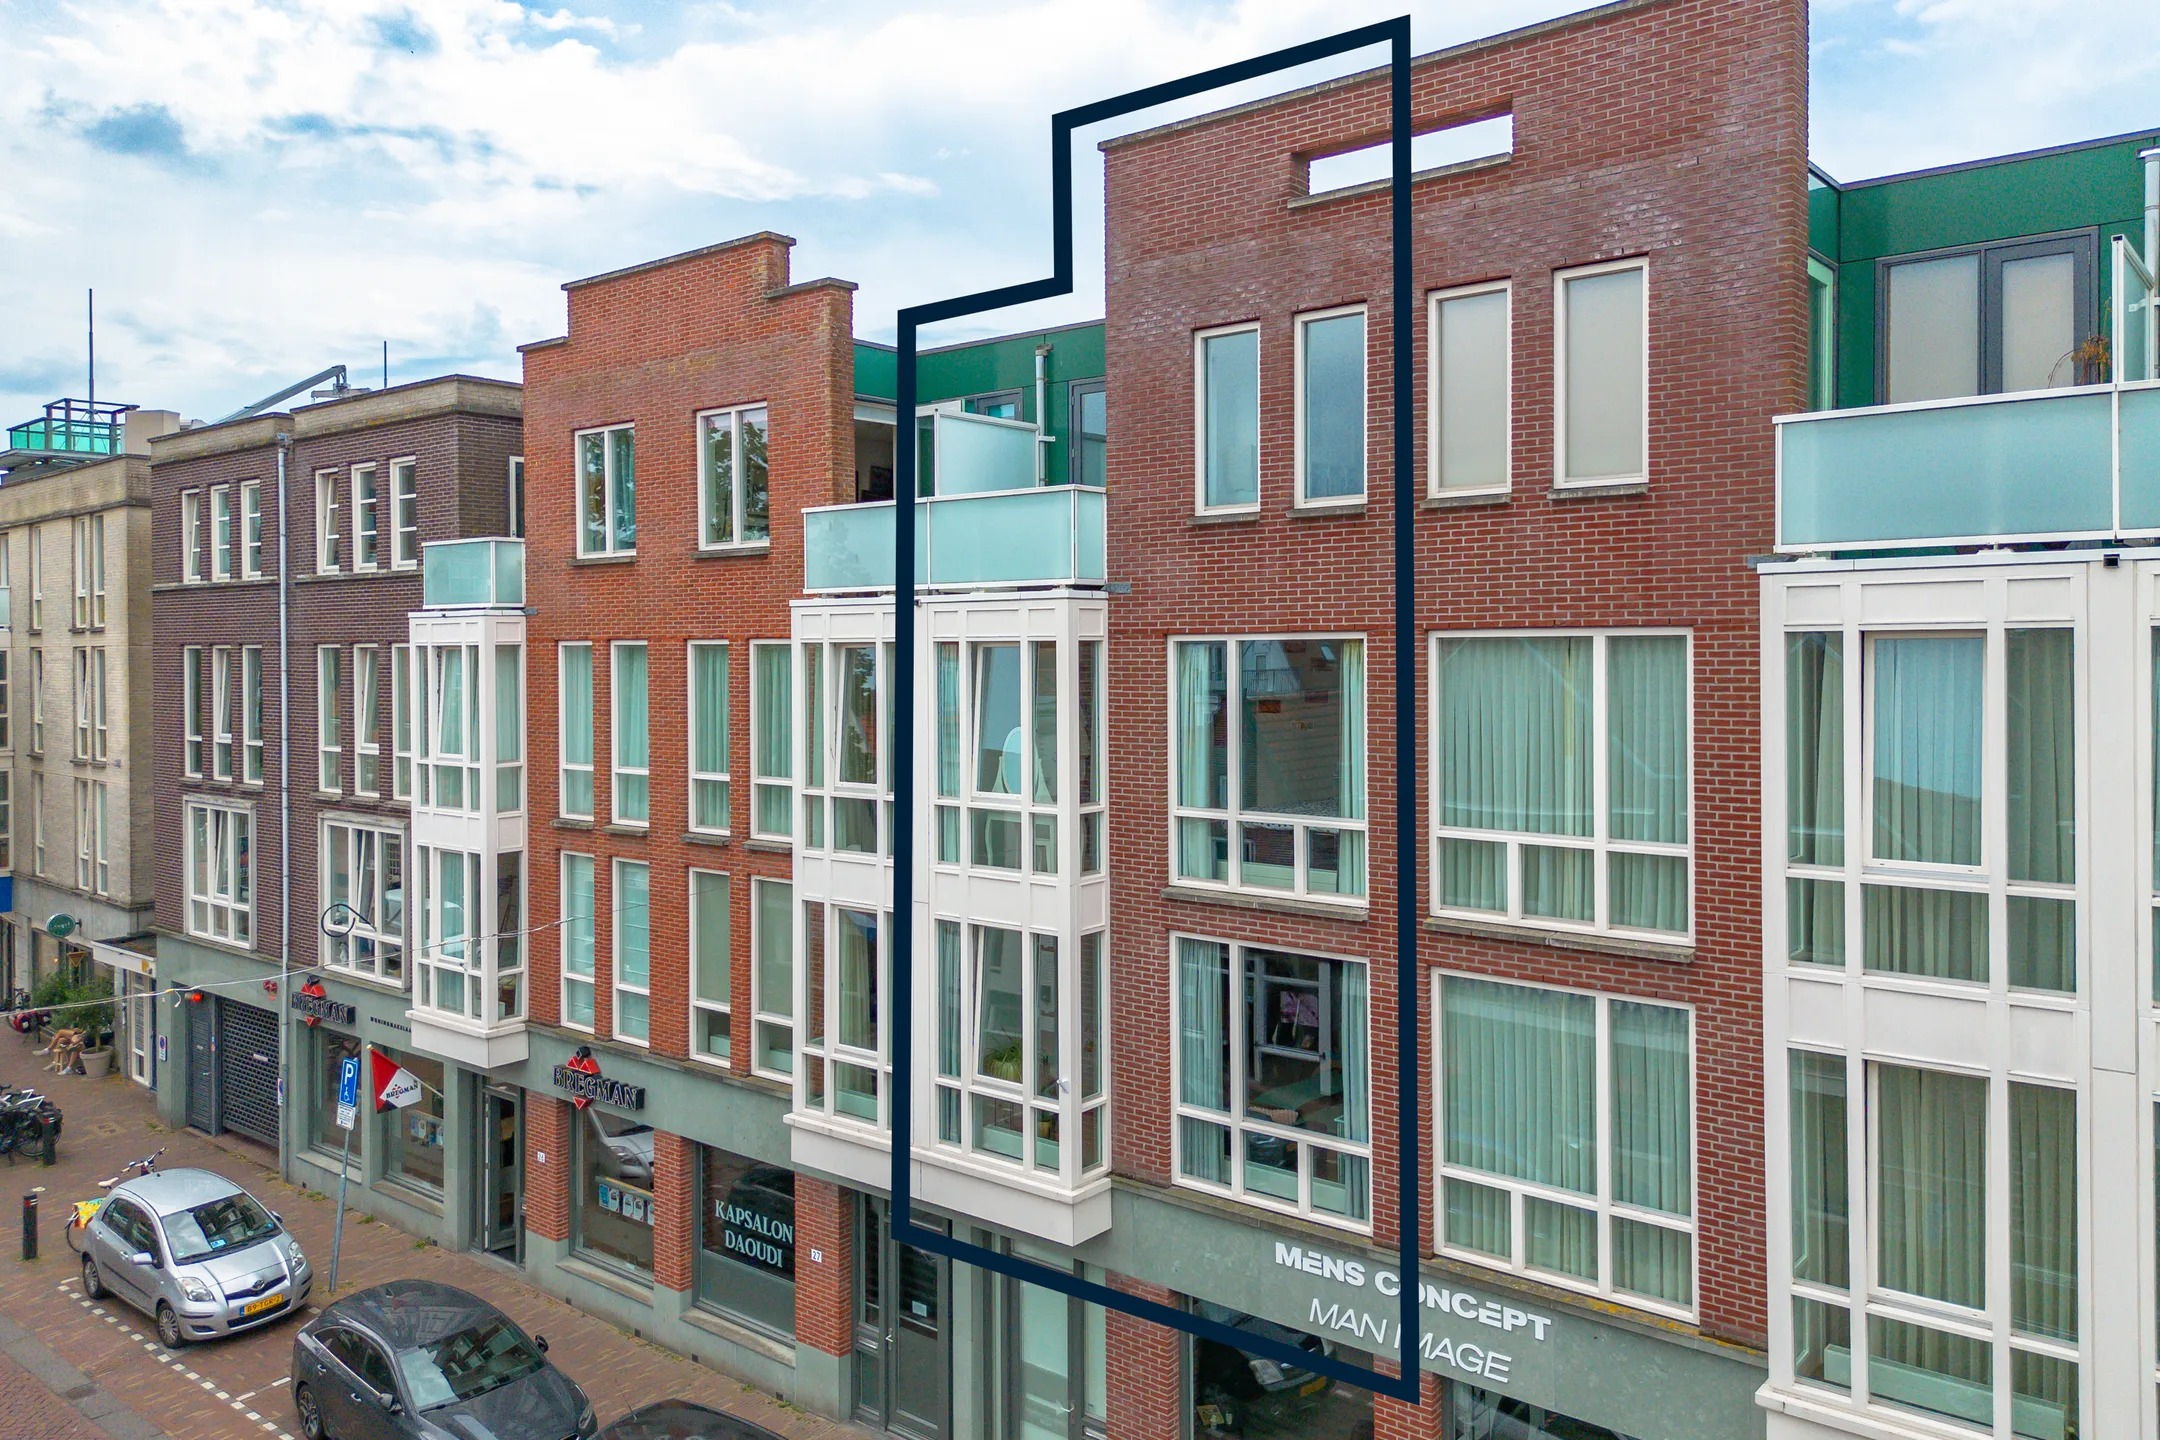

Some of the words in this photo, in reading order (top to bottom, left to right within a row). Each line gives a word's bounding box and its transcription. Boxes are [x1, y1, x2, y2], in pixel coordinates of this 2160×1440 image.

[291, 992, 356, 1025] BREGMAN
[344, 1064, 354, 1085] P
[386, 1084, 418, 1099] BREGMAN
[553, 1065, 643, 1111] BREGMAN
[715, 1200, 793, 1244] KAPSALON
[724, 1229, 783, 1268] DAOUDI
[812, 1251, 821, 1261] 27
[1275, 1241, 1365, 1287] MENS
[1374, 1271, 1551, 1341] CNCEPT
[1308, 1297, 1388, 1344] MAN
